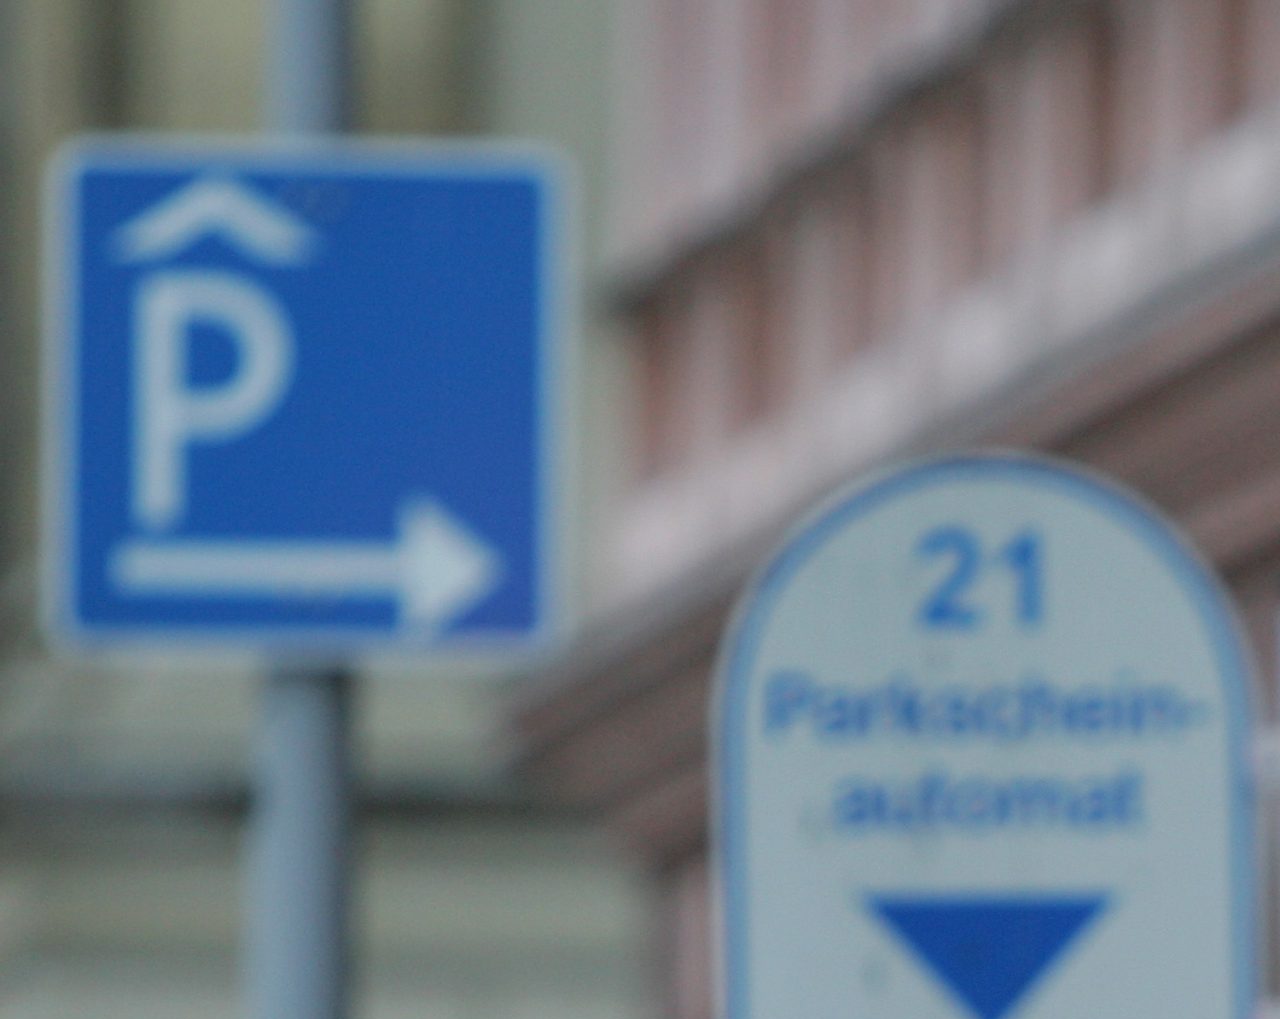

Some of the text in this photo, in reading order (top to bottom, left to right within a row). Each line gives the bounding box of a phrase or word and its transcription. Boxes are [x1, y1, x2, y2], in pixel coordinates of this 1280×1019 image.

[134, 268, 294, 528] P
[916, 526, 1044, 631] 21
[836, 772, 1146, 832] automat
